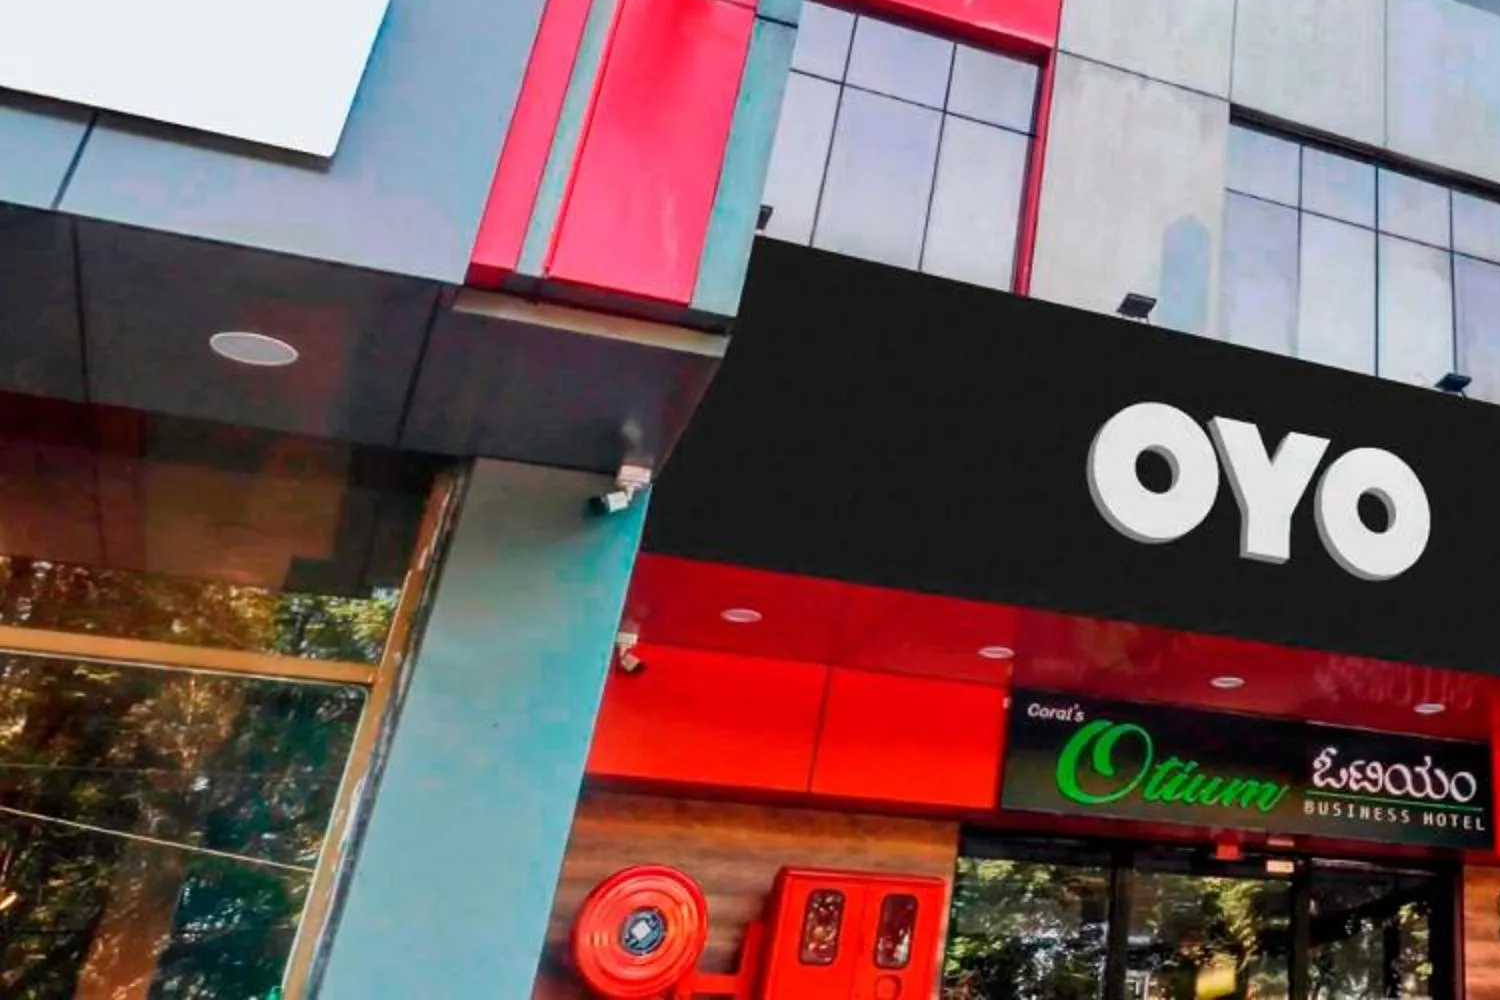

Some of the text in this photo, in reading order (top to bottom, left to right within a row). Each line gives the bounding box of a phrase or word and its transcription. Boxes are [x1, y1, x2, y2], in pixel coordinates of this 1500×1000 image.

[1086, 401, 1431, 581] OYO
[1056, 719, 1289, 812] Otium
[1304, 800, 1486, 831] BUSINESS HOTEL
